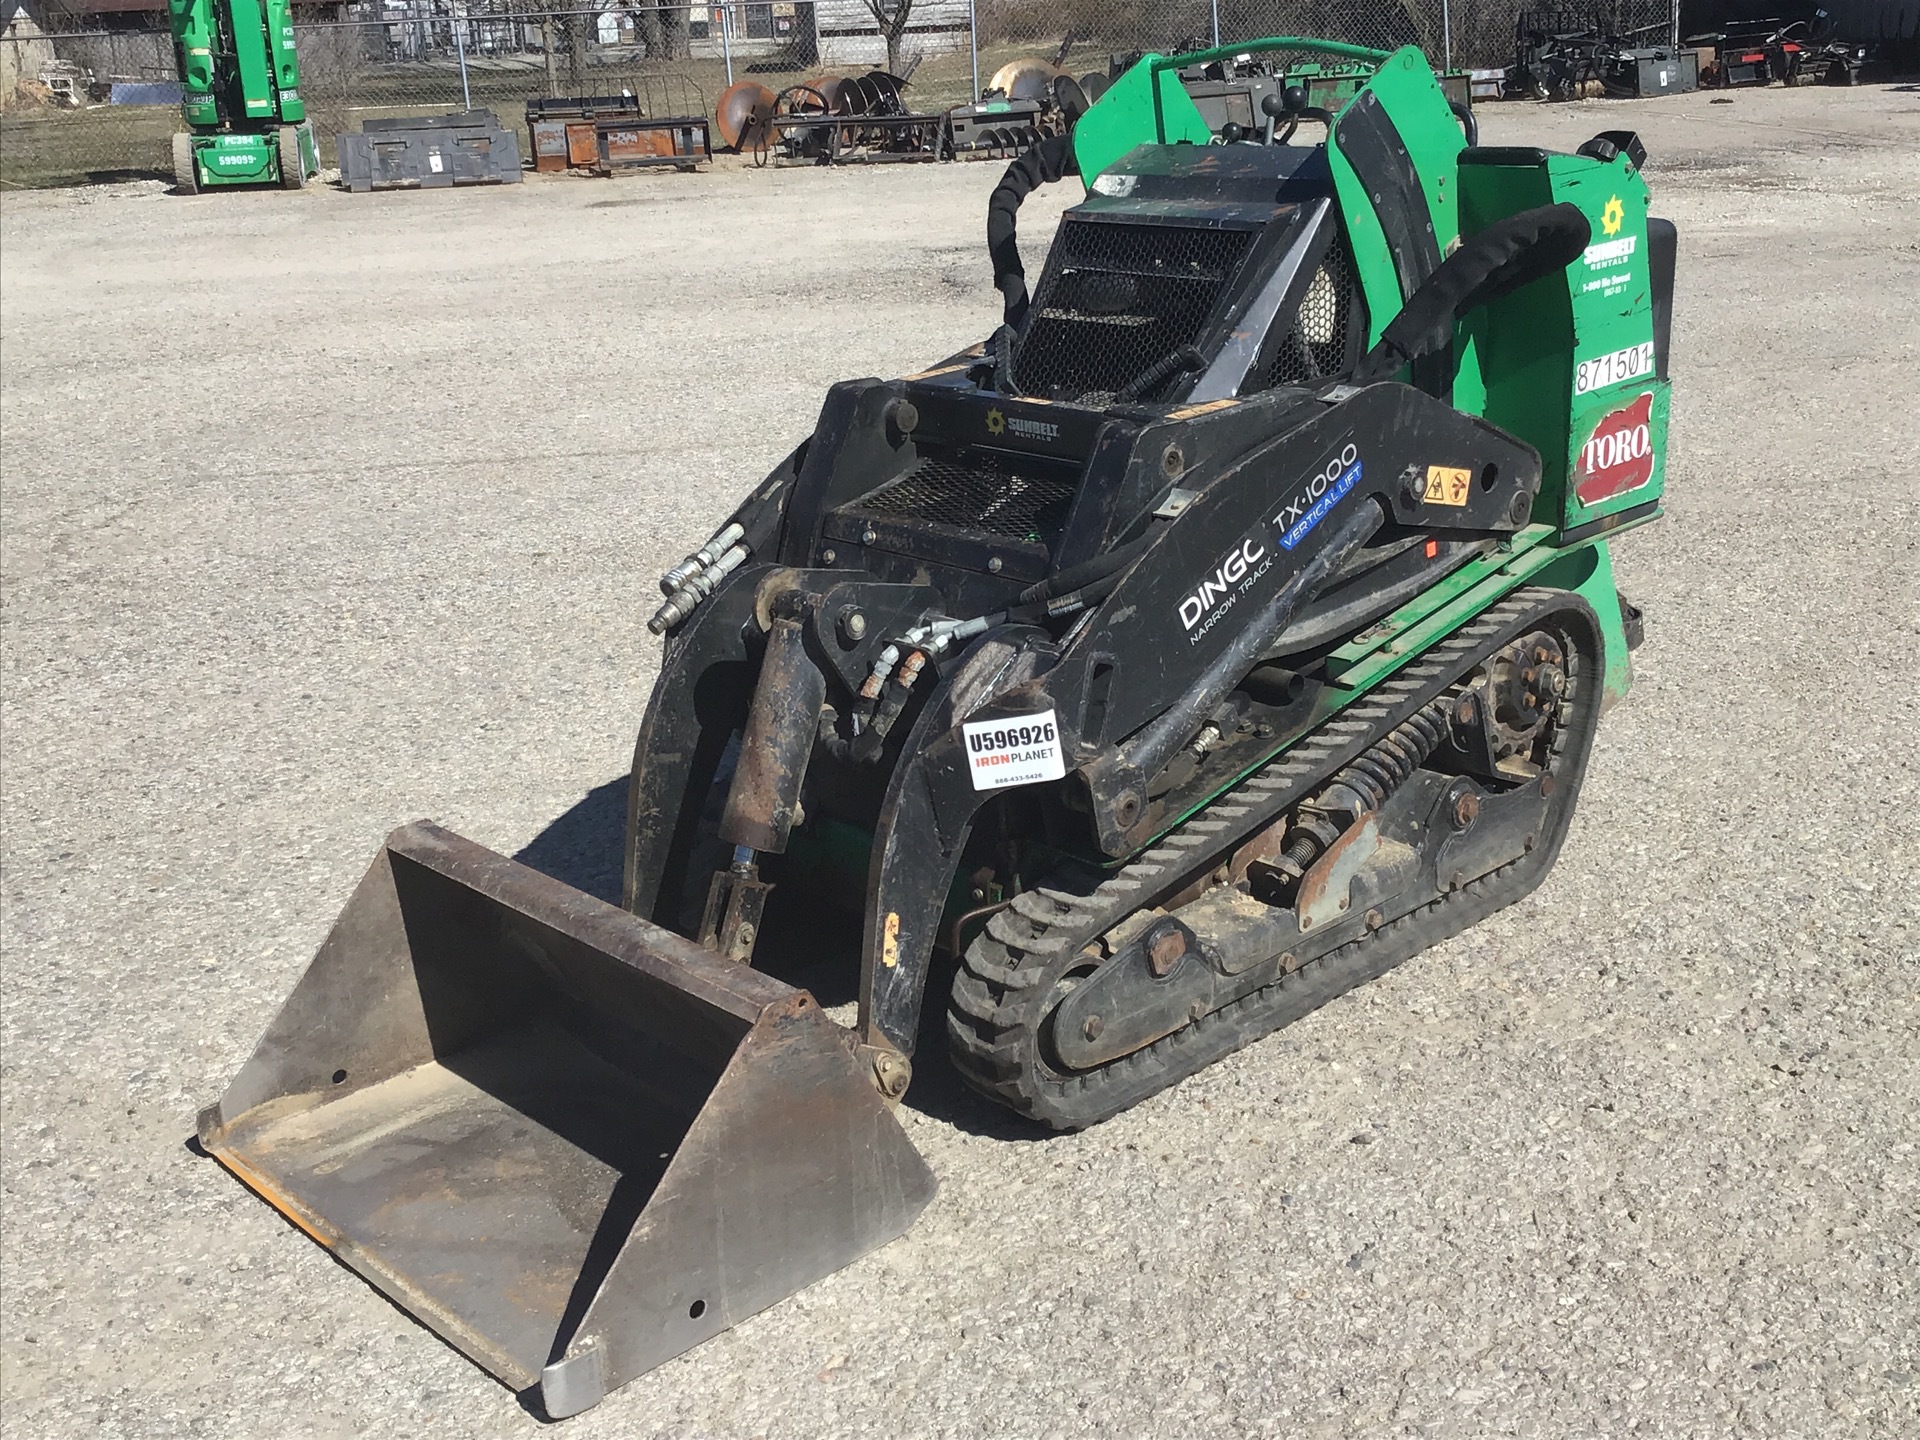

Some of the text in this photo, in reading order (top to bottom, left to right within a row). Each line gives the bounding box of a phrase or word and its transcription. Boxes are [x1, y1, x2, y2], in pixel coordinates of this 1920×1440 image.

[218, 154, 255, 166] 599099
[1583, 235, 1637, 265] SUNBELT
[1590, 255, 1629, 271] RENTALS
[1577, 344, 1650, 392] 871501
[1007, 417, 1059, 437] SUNBELT
[1014, 430, 1052, 442] RENTALS
[1581, 424, 1650, 475] TORO
[1283, 465, 1360, 546] VERTICAL LIFT
[1189, 556, 1273, 646] NARROW TRACK
[969, 722, 1055, 753] U596926
